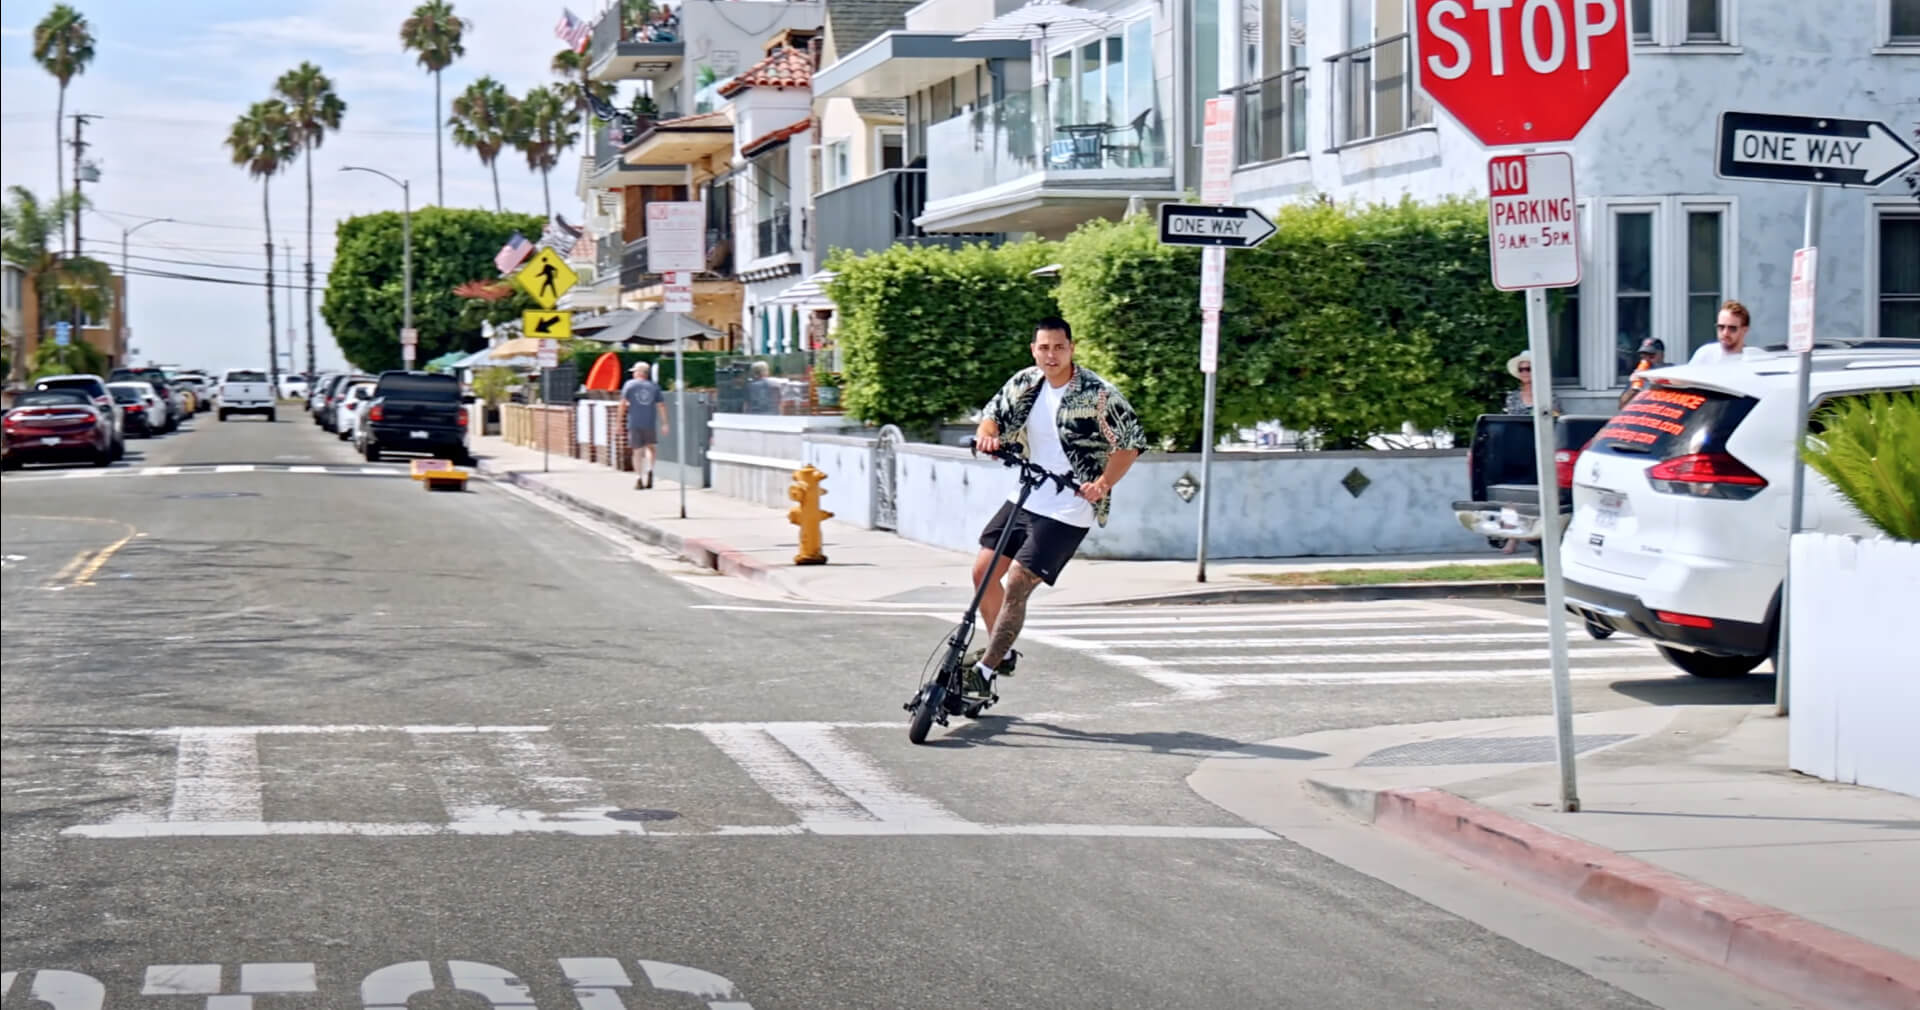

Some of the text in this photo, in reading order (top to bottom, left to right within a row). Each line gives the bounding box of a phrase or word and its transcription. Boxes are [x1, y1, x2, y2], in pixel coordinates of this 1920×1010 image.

[1427, 0, 1618, 80] STOP
[1743, 134, 1863, 165] ONE WAY
[1492, 161, 1523, 191] NO
[1174, 218, 1244, 235] ONE WAY
[1495, 198, 1571, 226] PARKING
